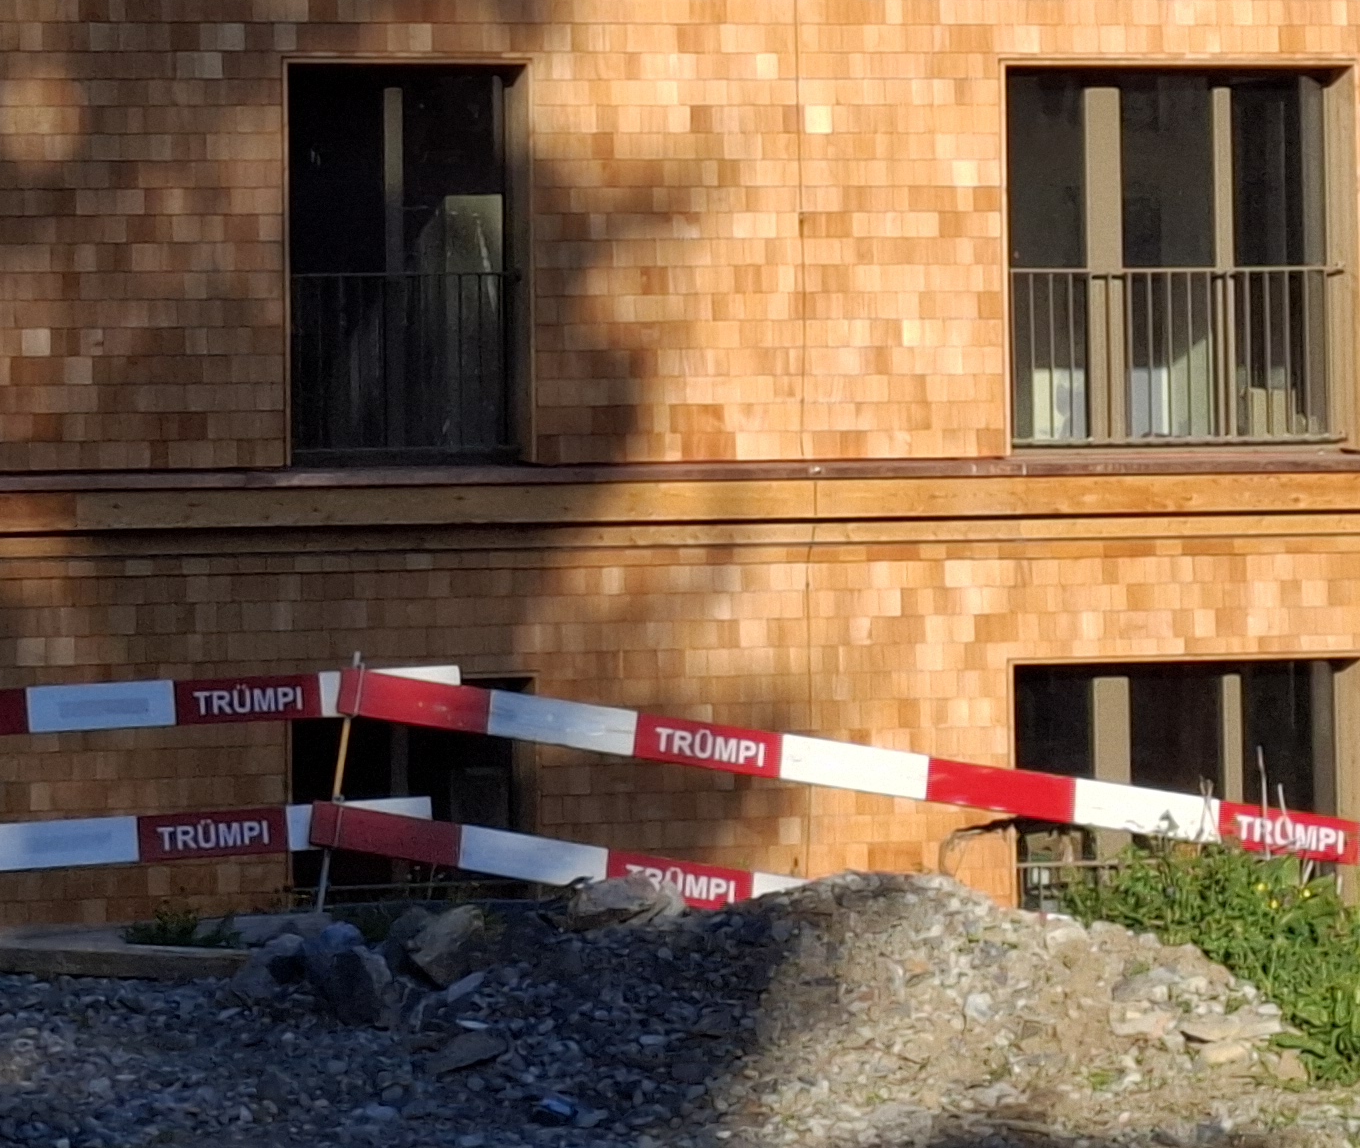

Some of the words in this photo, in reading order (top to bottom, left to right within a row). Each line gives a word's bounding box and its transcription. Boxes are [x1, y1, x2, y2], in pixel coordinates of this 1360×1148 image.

[193, 684, 303, 716] TRÜMPI
[655, 727, 765, 768] TRÜMPI
[156, 818, 270, 851] TRÜMPI
